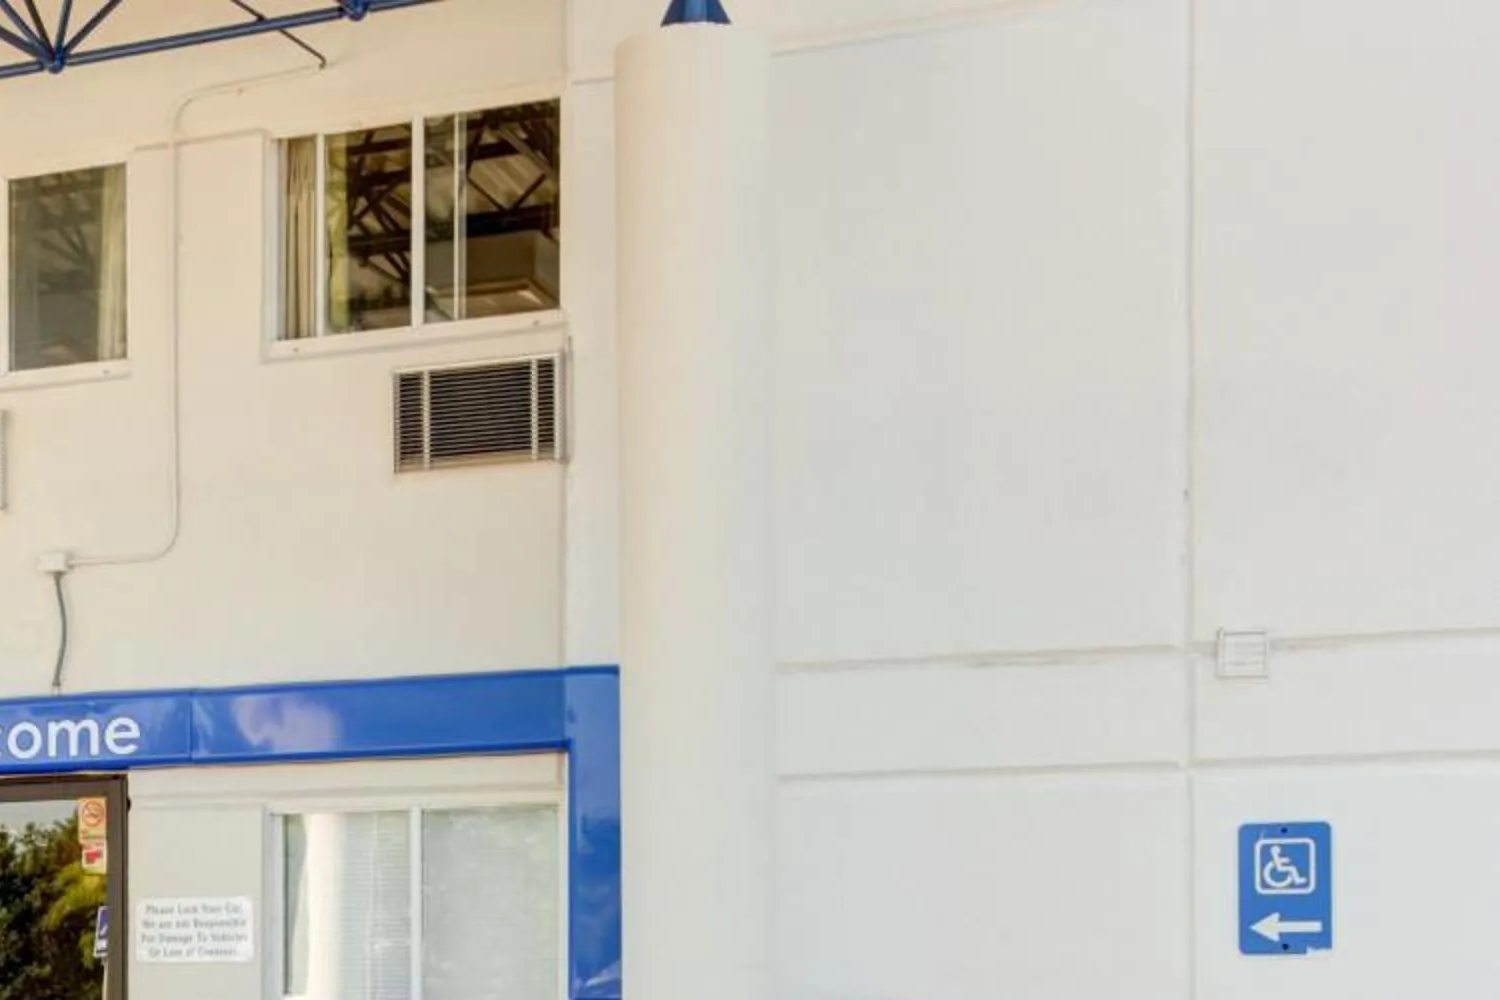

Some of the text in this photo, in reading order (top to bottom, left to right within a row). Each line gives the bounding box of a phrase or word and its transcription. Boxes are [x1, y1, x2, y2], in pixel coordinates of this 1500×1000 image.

[145, 903, 175, 914] Please
[177, 901, 198, 915] Lock
[202, 903, 222, 913] Your
[143, 919, 156, 929] We
[193, 918, 247, 930] Responsible
[141, 932, 156, 943] For
[159, 932, 193, 945] Damage
[210, 931, 248, 943] Vehicles
[148, 946, 161, 957] Or
[163, 946, 183, 957] Loss
